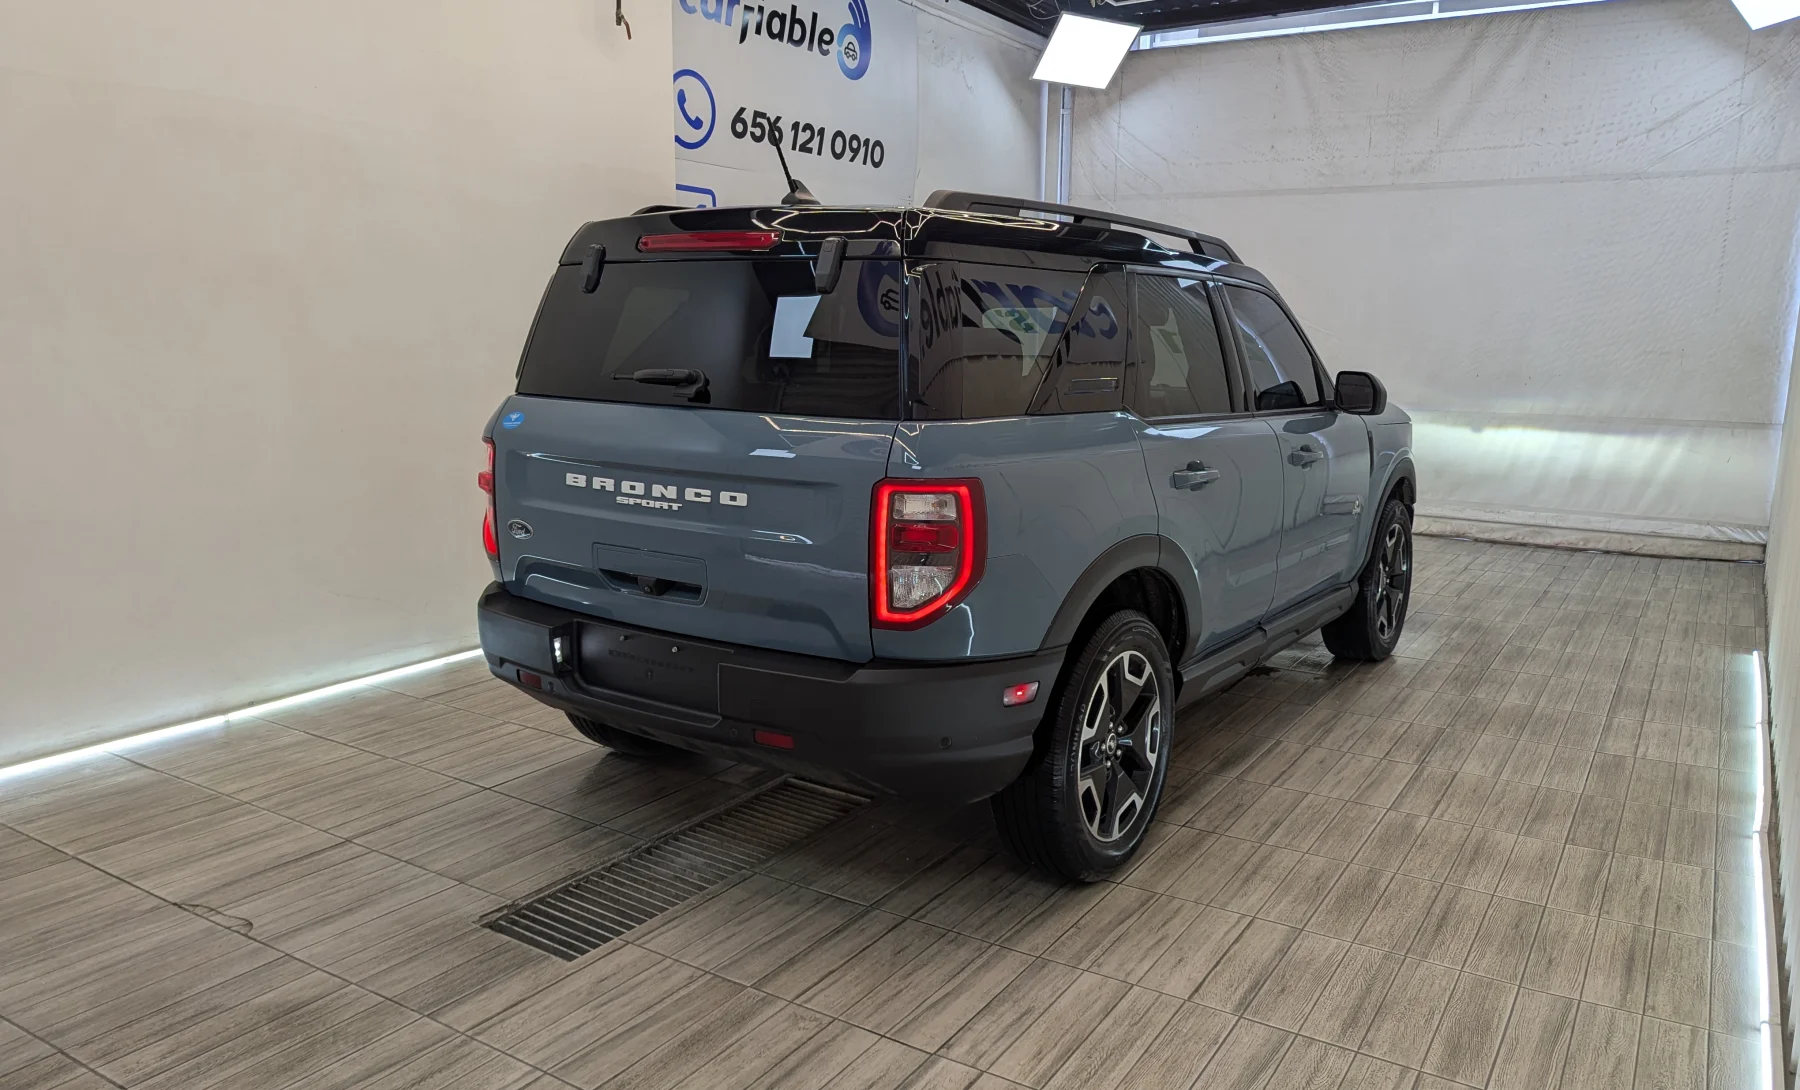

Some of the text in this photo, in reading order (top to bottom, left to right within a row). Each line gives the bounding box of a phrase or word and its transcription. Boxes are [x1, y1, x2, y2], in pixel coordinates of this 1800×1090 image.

[731, 106, 885, 169] 656 121 0910
[565, 472, 748, 507] BRONCO
[615, 496, 683, 511] SPORT
